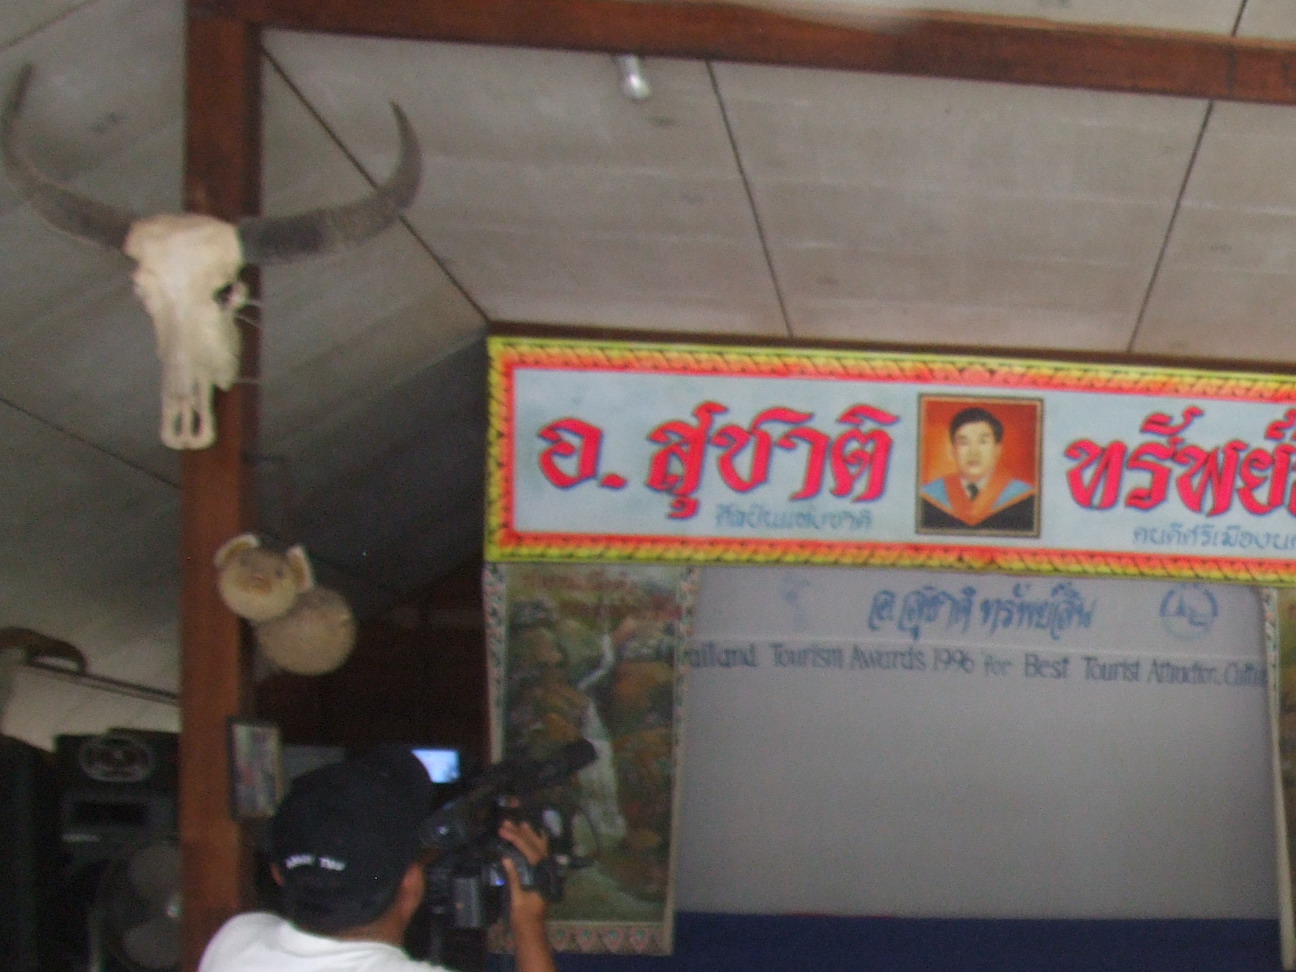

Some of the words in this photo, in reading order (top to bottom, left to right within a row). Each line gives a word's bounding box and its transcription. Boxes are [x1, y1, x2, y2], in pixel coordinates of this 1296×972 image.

[770, 641, 845, 670] Tourism
[849, 643, 927, 672] Awards
[1023, 652, 1071, 681] Best
[1081, 655, 1141, 683] Tourist
